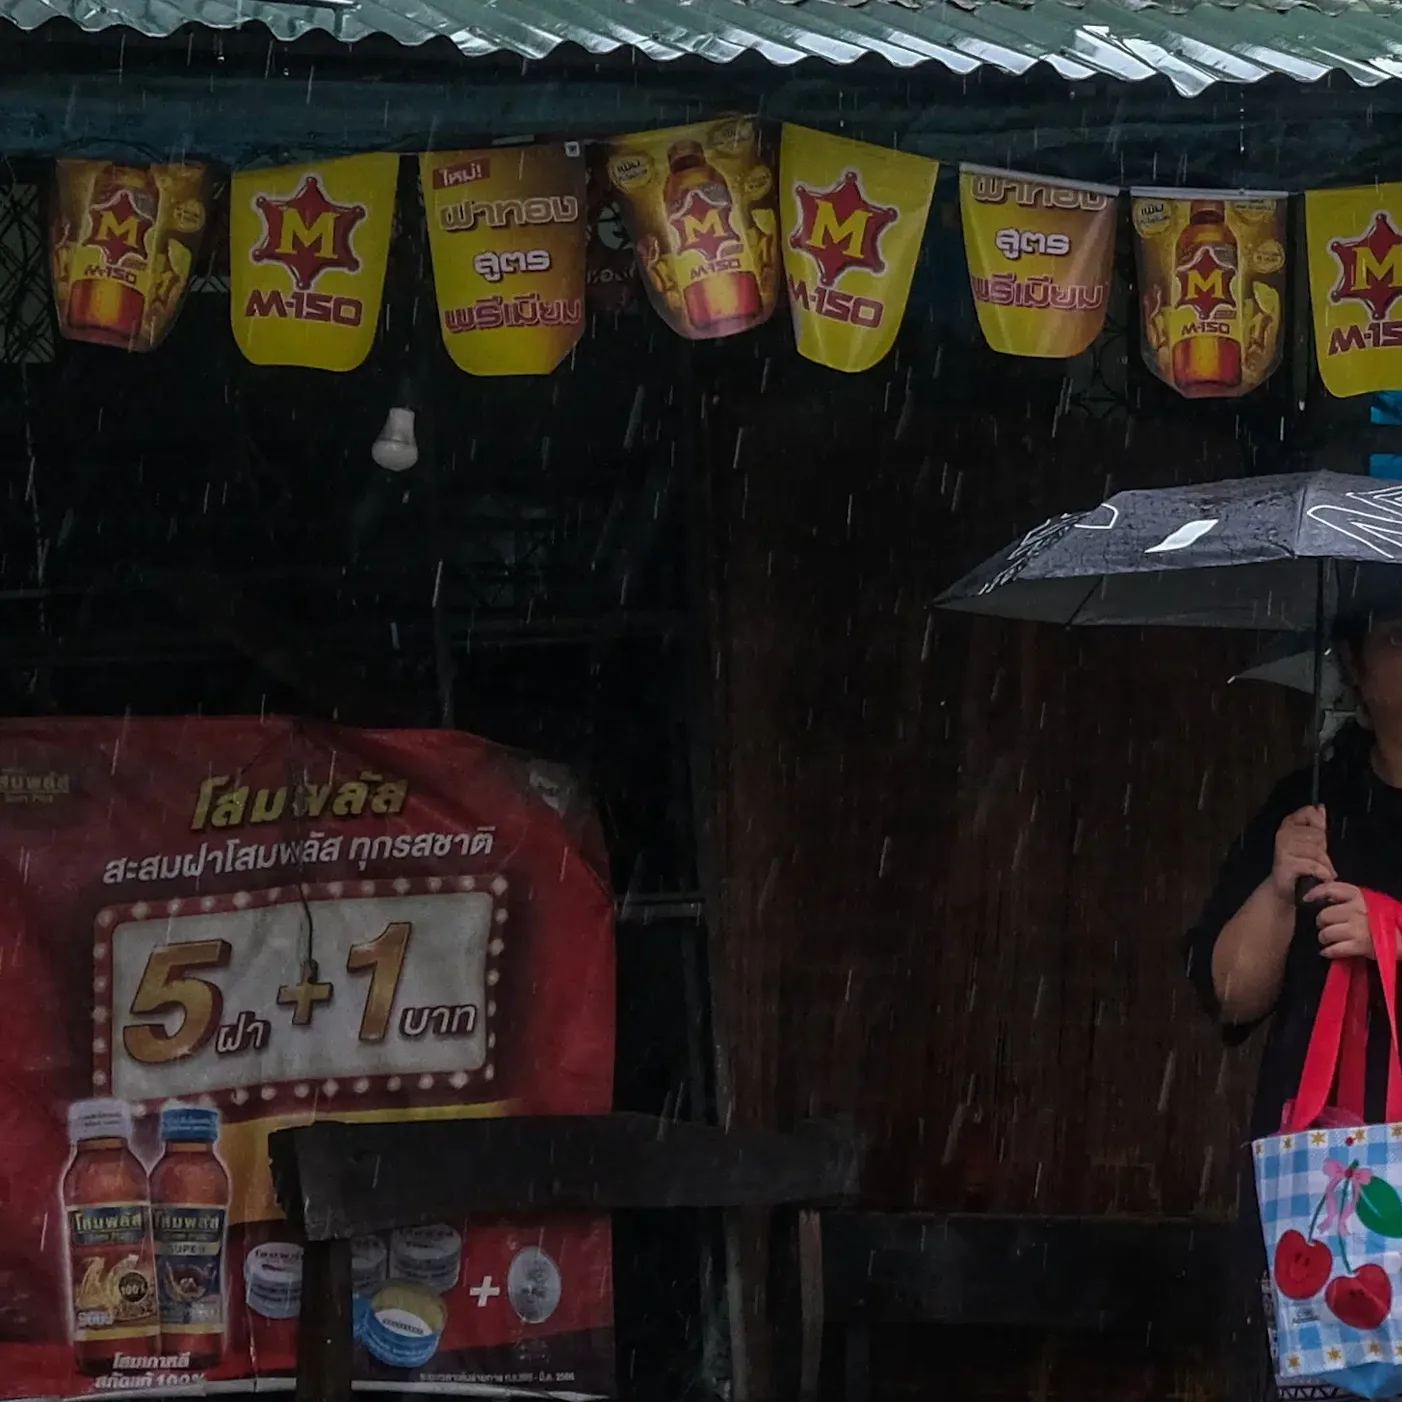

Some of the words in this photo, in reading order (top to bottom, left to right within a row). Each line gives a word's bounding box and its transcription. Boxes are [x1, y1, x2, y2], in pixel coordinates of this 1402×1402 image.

[94, 210, 140, 249] M
[275, 206, 341, 260] M
[683, 208, 728, 245] M
[805, 198, 873, 259] M
[995, 227, 1070, 260] สูตร
[473, 249, 551, 282] สูตร
[690, 257, 742, 280] M-150
[1184, 268, 1225, 300] M
[245, 289, 363, 326] M-150
[788, 274, 884, 328] M-150
[1181, 321, 1230, 336] M-150
[348, 826, 497, 871] ทุกรสชาติ
[122, 938, 232, 1064] 5
[216, 1011, 270, 1055] ฝา
[346, 921, 413, 1043] 1
[399, 1002, 477, 1038] บาท
